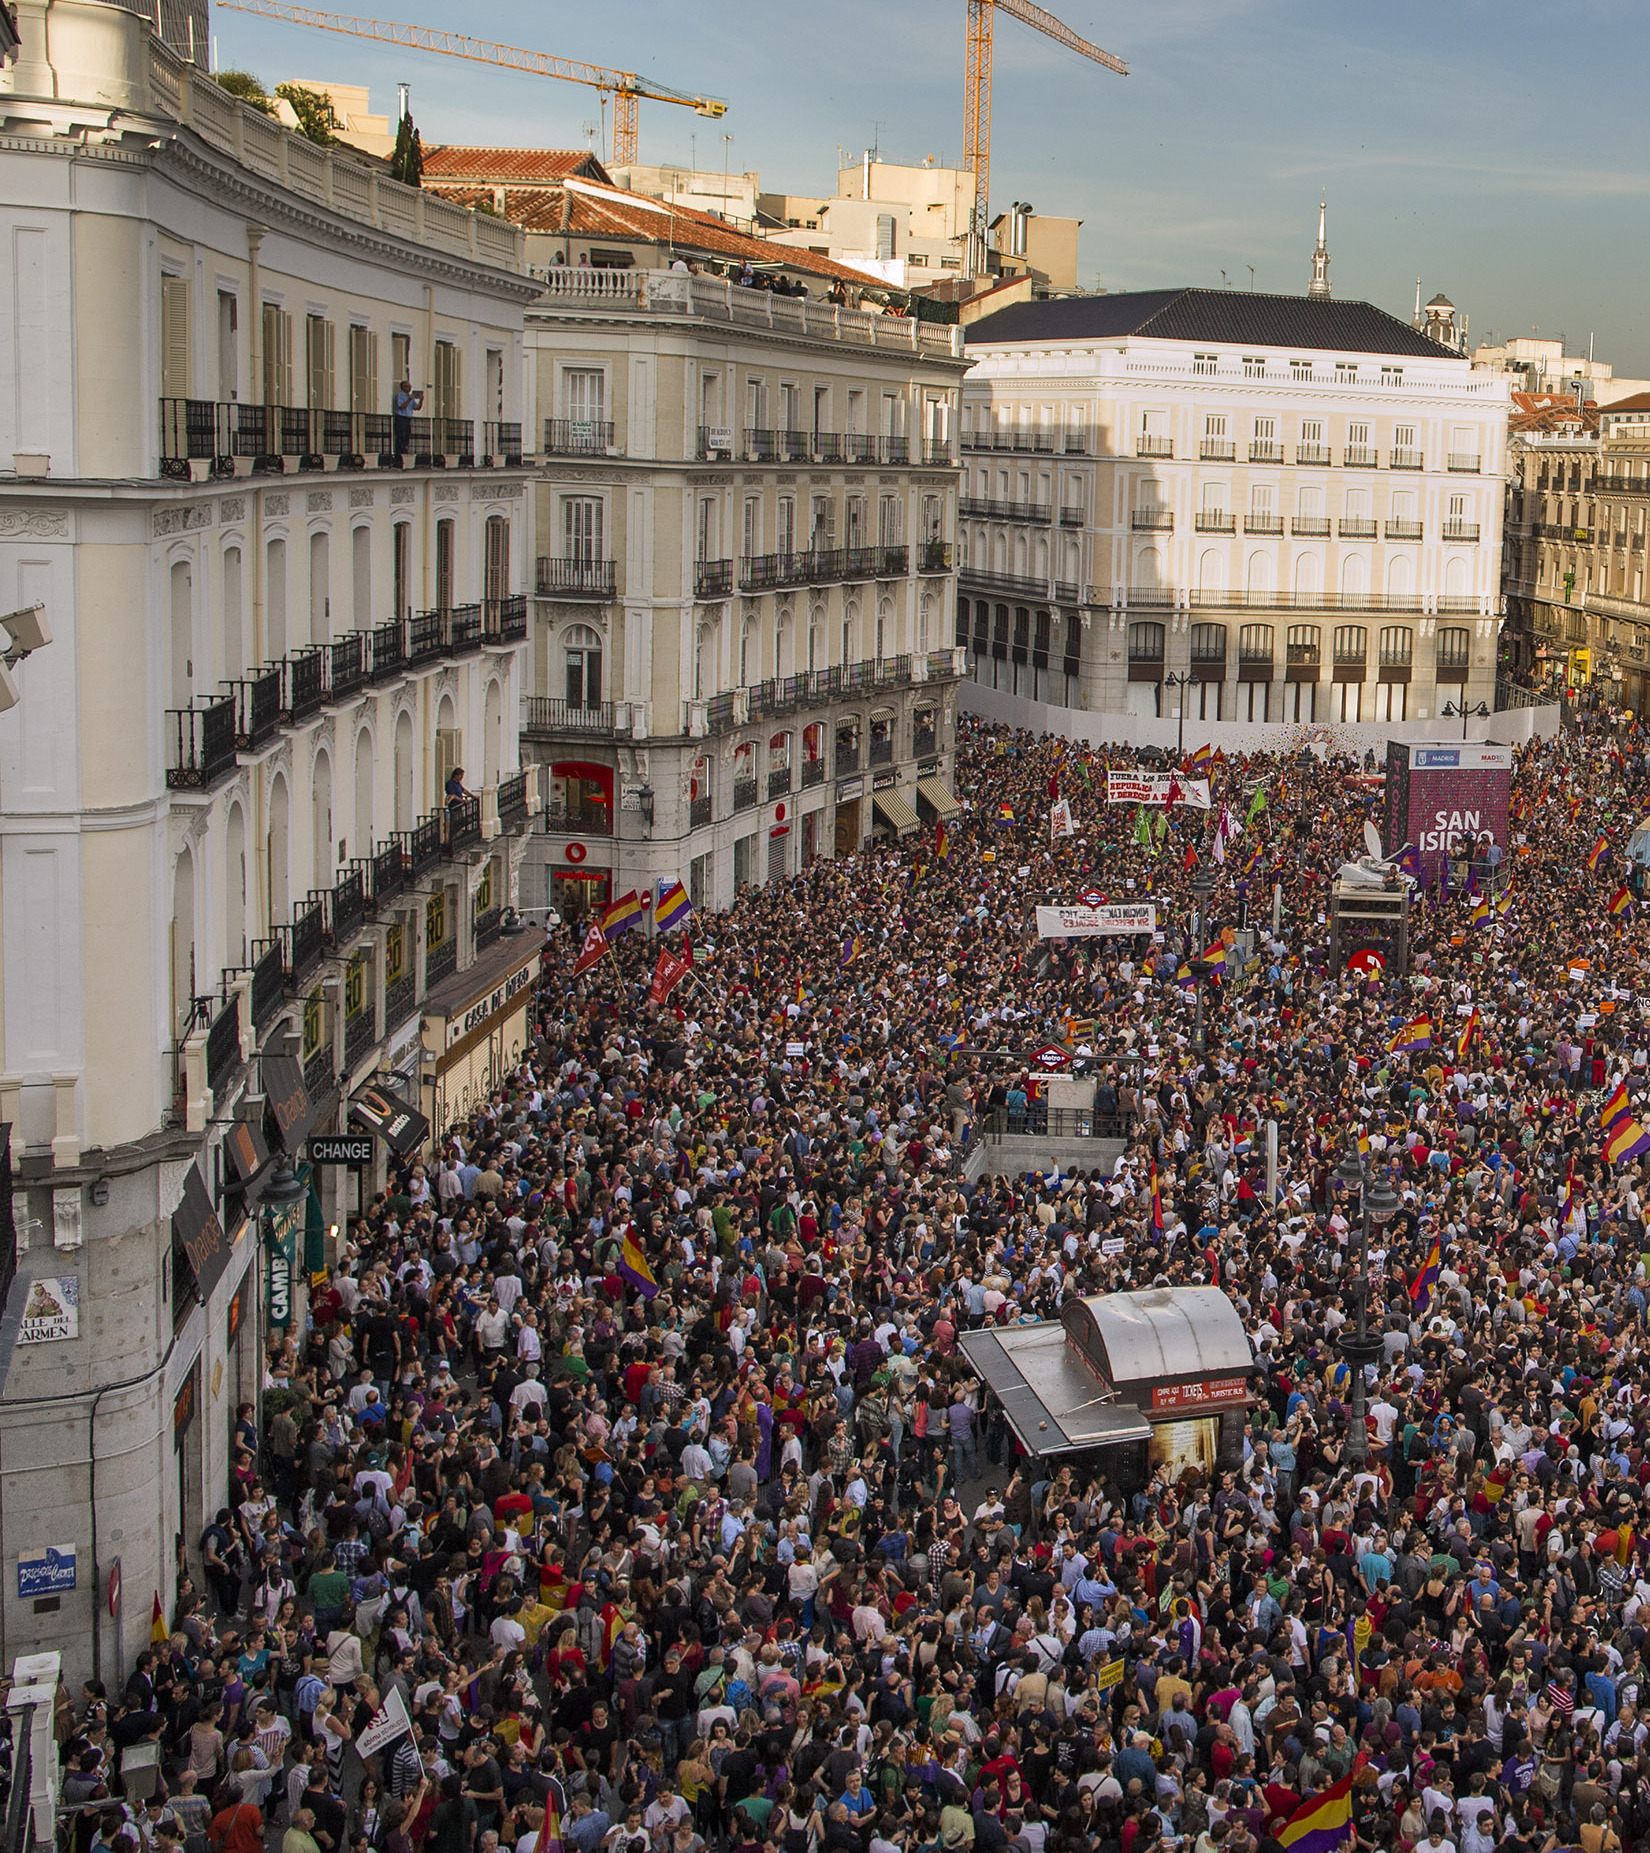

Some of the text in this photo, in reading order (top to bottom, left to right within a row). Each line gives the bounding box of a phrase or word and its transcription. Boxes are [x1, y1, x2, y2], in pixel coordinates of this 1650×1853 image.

[1110, 772, 1140, 782] FUERA
[1142, 774, 1155, 782] LOS
[1110, 791, 1116, 800] Y
[1152, 793, 1159, 801] A
[1435, 810, 1480, 831] SAN
[554, 871, 603, 882] vodafone
[465, 1000, 488, 1032] CASA
[491, 989, 505, 1011] DE
[1638, 998, 1650, 1008] NO
[276, 1086, 307, 1131] Orange
[312, 1142, 371, 1159] CHANGE
[184, 1213, 222, 1275] Orange
[270, 1254, 290, 1320] CAMB
[53, 1316, 71, 1325] DEL
[19, 1325, 68, 1342] ARMEN
